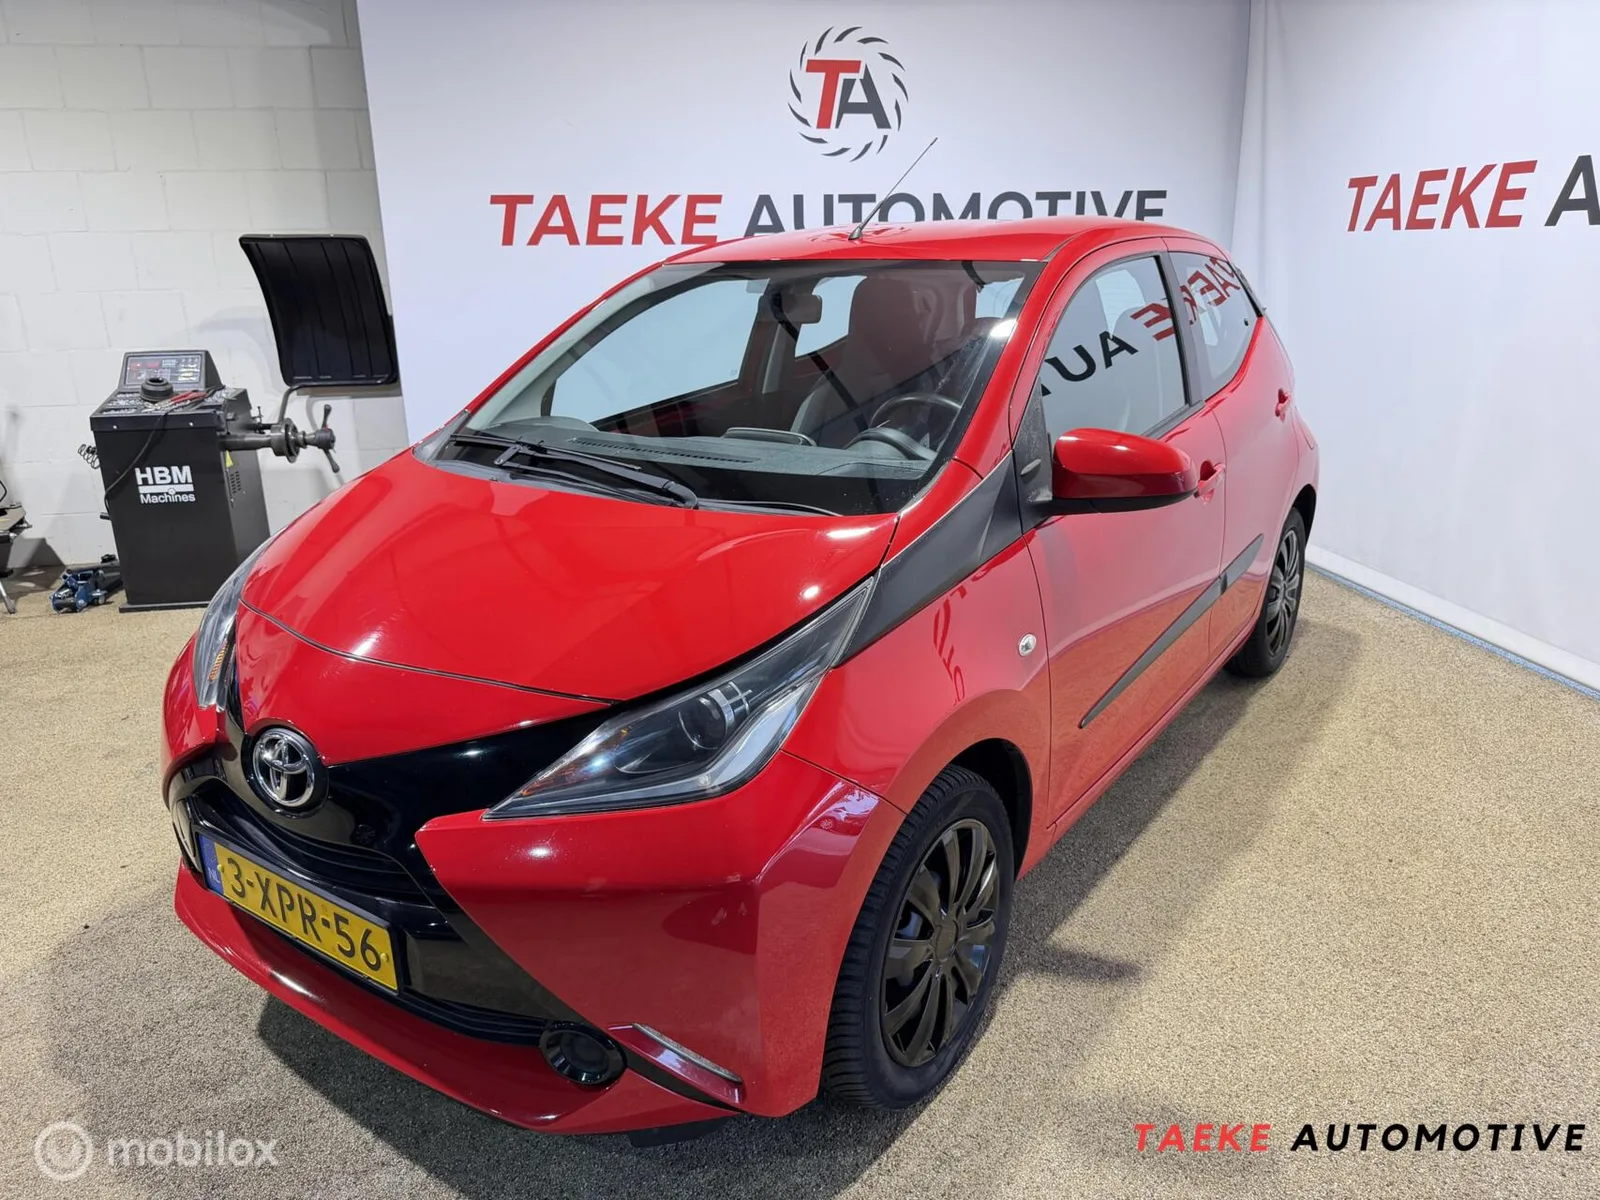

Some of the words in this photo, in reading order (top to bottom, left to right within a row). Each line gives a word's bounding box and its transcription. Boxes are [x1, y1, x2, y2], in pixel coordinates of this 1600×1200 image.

[805, 59, 892, 129] TA
[490, 194, 723, 246] TAEKE
[1347, 159, 1538, 232] TAEKE
[134, 465, 193, 486] HBM
[139, 492, 196, 504] Machines
[207, 866, 221, 884] NL
[226, 857, 382, 971] 3-XPR-56
